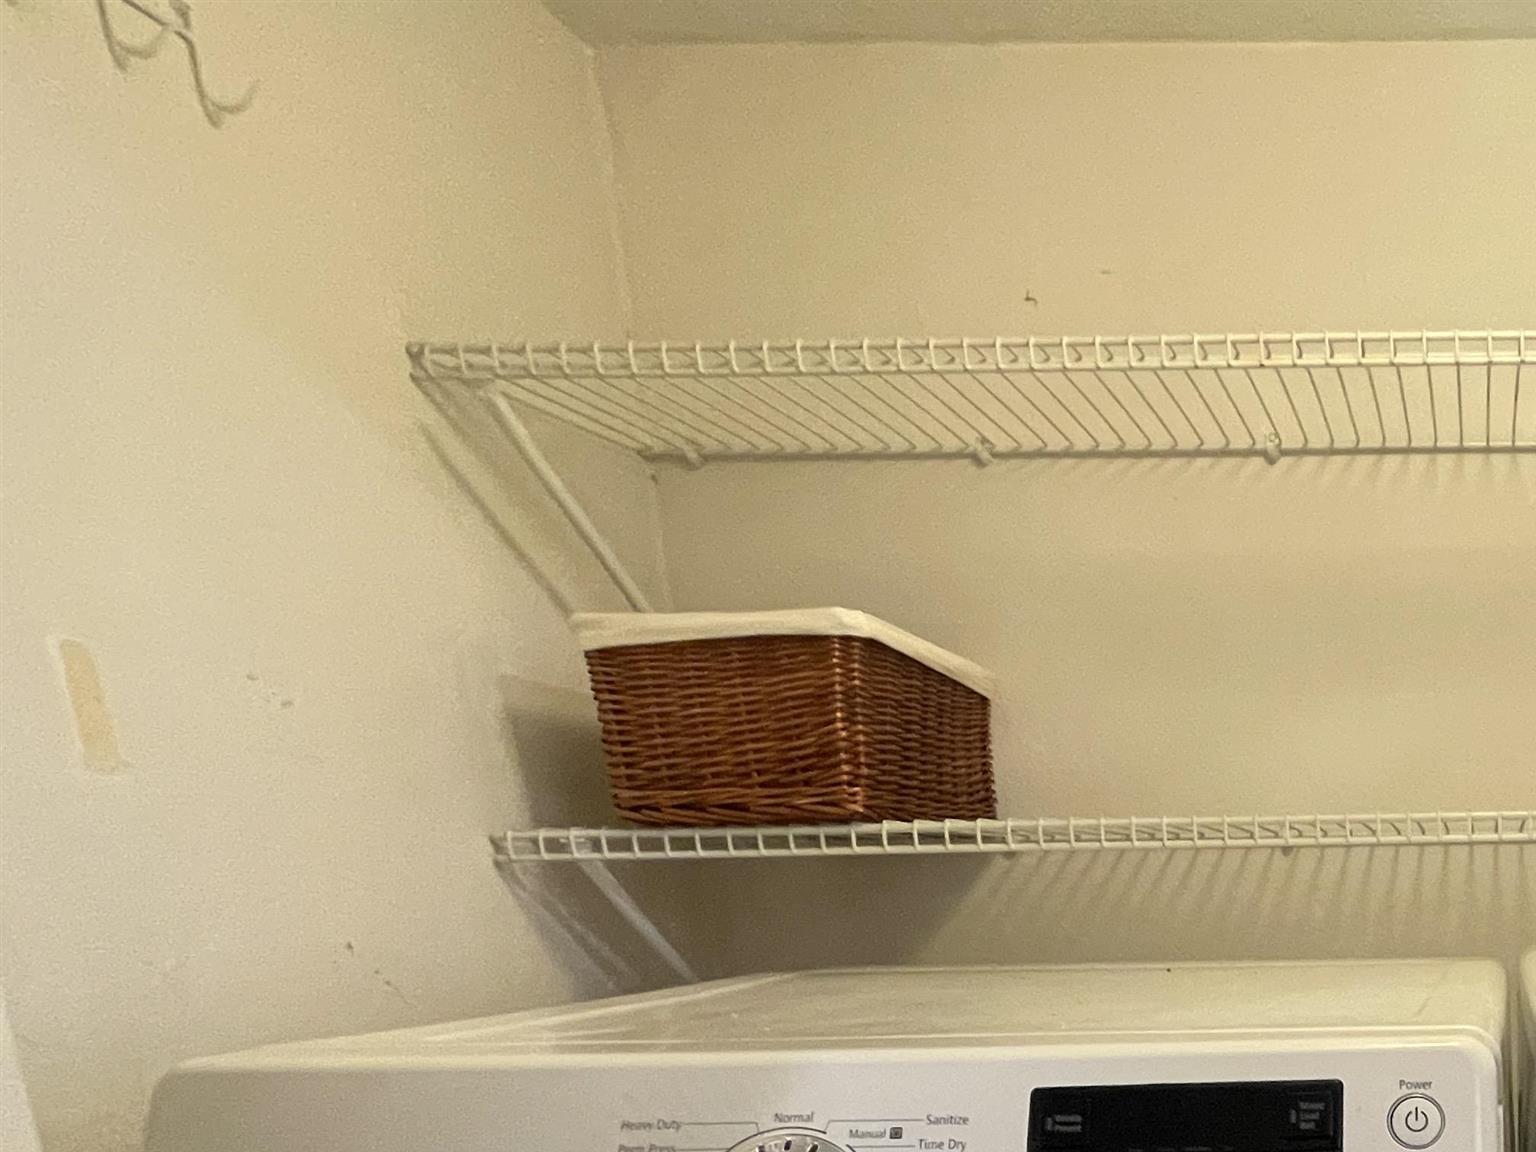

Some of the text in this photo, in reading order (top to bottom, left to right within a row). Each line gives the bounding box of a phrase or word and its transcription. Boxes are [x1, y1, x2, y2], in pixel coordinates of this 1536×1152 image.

[1399, 1079, 1433, 1090] Power
[774, 1111, 814, 1123] Normal
[926, 1113, 970, 1125] Sanitize
[849, 1128, 887, 1140] Manual
[918, 1138, 967, 1152] Time Dry
